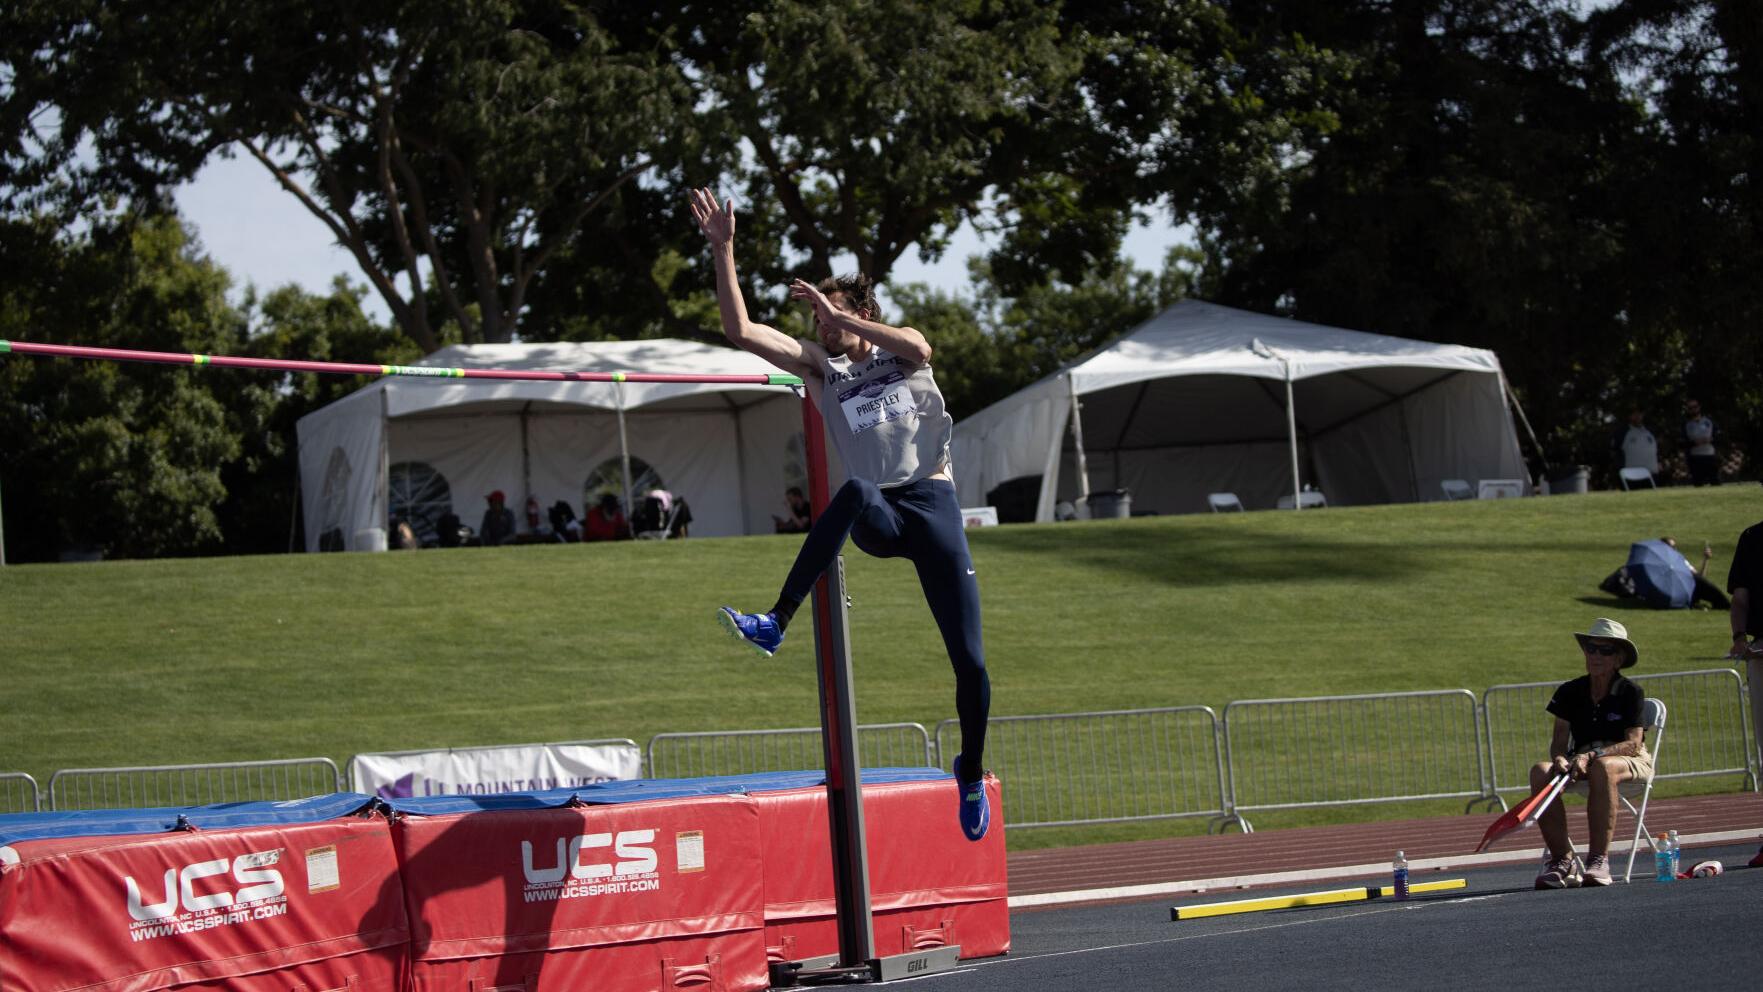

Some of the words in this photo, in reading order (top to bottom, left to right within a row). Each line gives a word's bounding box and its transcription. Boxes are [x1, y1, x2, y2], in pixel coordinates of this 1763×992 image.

[856, 392, 900, 416] PRIESTLEY
[457, 776, 558, 795] MOUNTAIN
[521, 829, 658, 883] UCS
[124, 849, 285, 921] UCS
[524, 880, 659, 902] WWW.UCSSPIRIT.COM
[130, 904, 287, 941] WWW.UCSSPIRIT.COM
[907, 958, 928, 973] GILL
